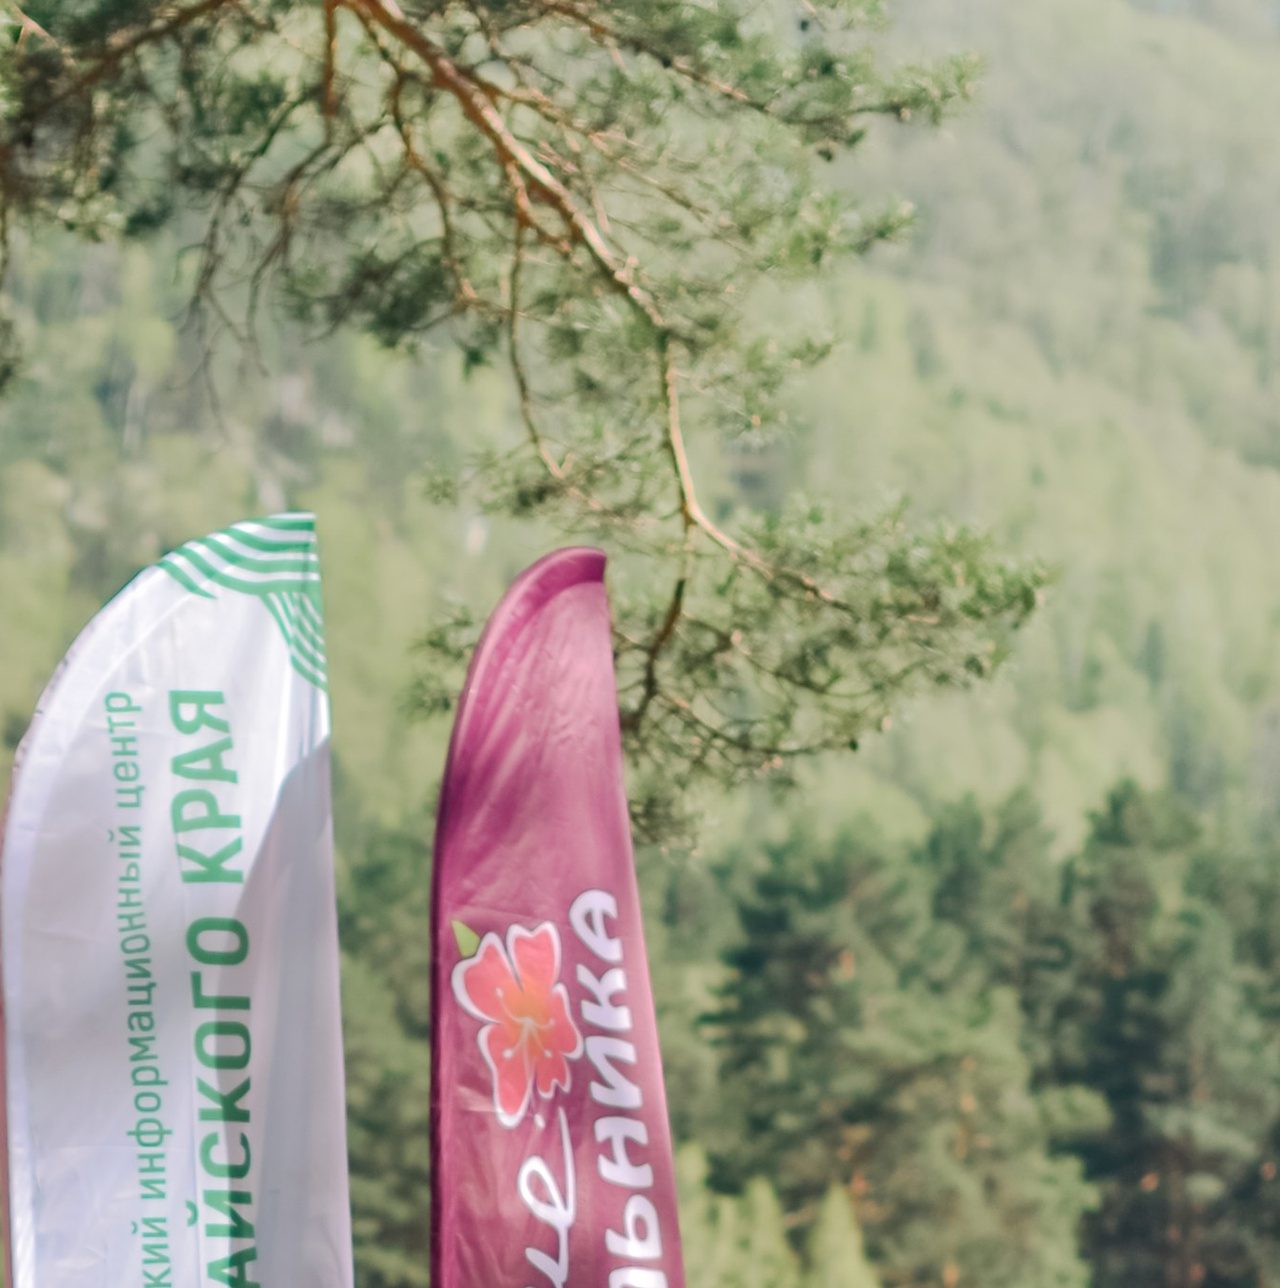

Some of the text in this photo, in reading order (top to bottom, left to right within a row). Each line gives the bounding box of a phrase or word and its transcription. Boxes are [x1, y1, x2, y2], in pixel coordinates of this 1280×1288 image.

[103, 690, 145, 808] центр
[168, 688, 243, 883] КРАЯ
[108, 824, 173, 1199] информационный
